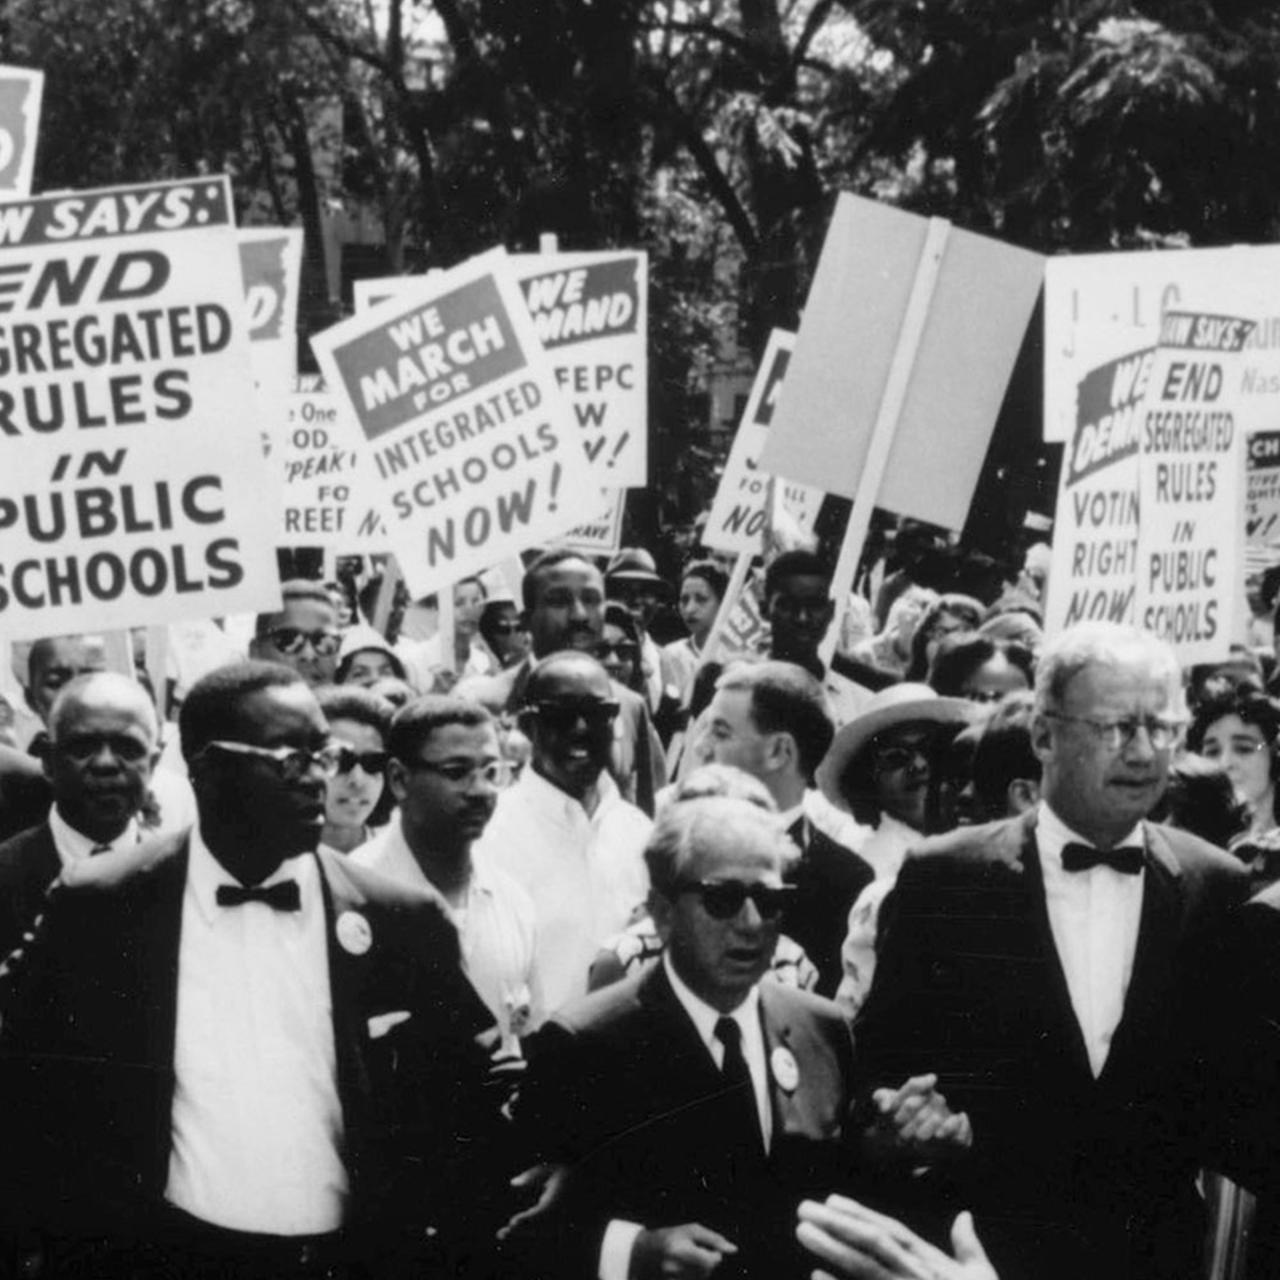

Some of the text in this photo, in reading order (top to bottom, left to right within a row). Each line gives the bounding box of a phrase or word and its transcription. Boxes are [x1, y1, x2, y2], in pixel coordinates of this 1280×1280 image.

[45, 185, 219, 242] SAYS:
[526, 268, 588, 314] WE
[388, 305, 446, 351] WE
[359, 315, 506, 412] MARCH
[553, 363, 634, 394] FEPC
[1160, 361, 1223, 402] END
[412, 372, 474, 412] FOR
[374, 380, 543, 480] INTEGRATED
[1143, 410, 1235, 455] SEGREGATED
[50, 448, 129, 484] IN
[391, 423, 560, 520] SCHOOLS
[1155, 460, 1218, 503] RULES
[427, 462, 562, 568] NOW!
[1171, 520, 1196, 544] IN
[1149, 547, 1218, 594] PUBLIC
[1143, 599, 1219, 644] SCHOOLS
